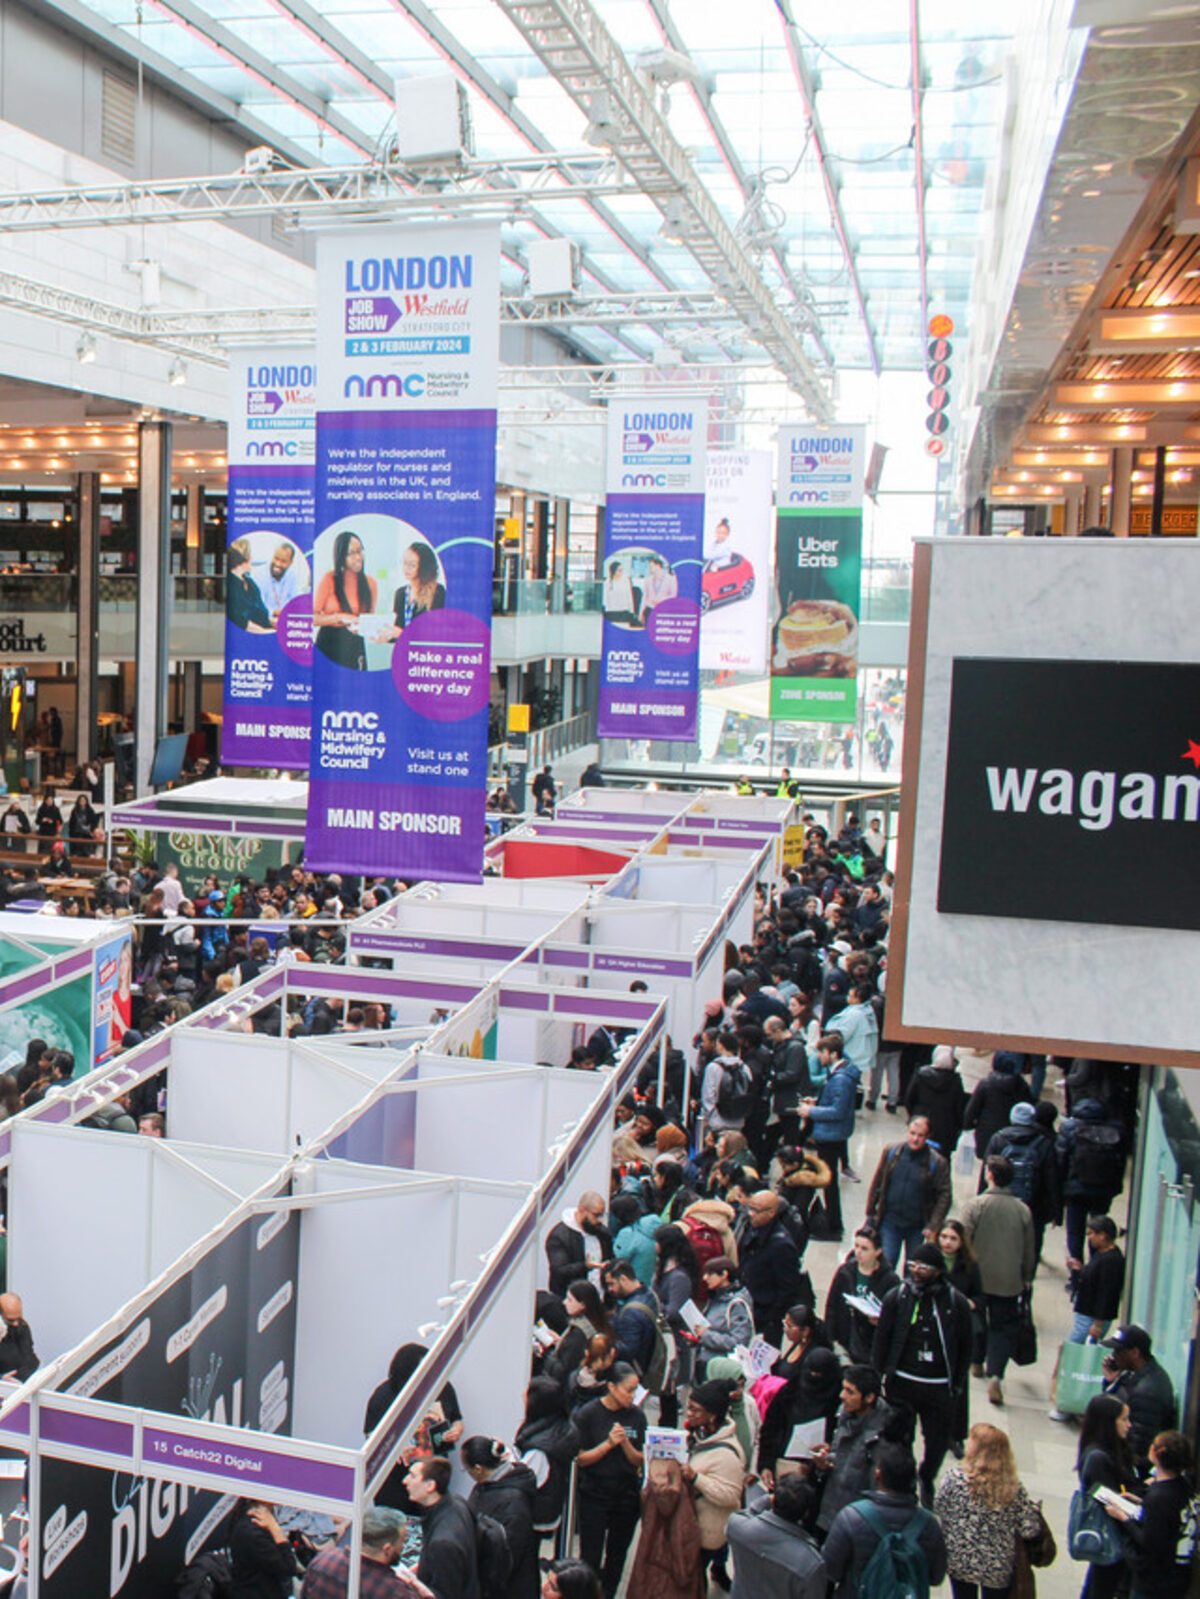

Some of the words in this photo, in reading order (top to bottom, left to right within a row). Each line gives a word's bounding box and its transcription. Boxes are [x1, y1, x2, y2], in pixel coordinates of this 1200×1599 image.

[345, 255, 472, 292] LONDON
[348, 300, 373, 315] JOB
[404, 295, 470, 317] Westfield
[348, 315, 388, 331] SHOW
[403, 322, 449, 333] STRATFORD
[452, 321, 470, 331] CITY
[352, 342, 359, 353] 2
[361, 342, 369, 353] &
[371, 341, 378, 352] 3
[381, 340, 434, 352] FEBRUARY
[437, 339, 462, 350] 2024
[427, 372, 462, 382] Nursing
[465, 372, 469, 380] &
[344, 373, 424, 397] nmc
[427, 381, 469, 390] Midwifery
[931, 339, 948, 433] BOWL
[427, 389, 459, 397] Council
[623, 413, 693, 430] LONDON
[246, 441, 298, 456] nmc
[791, 438, 853, 454] LONDON
[328, 448, 356, 458] We're
[359, 448, 377, 458] the
[379, 448, 446, 461] independent
[327, 462, 374, 473] regulator
[376, 462, 391, 472] for
[394, 463, 428, 472] nurses
[431, 462, 451, 472] and
[327, 476, 375, 486] midwives
[377, 476, 387, 486] in
[390, 476, 407, 486] the
[409, 476, 428, 487] UK,
[431, 475, 450, 486] and
[622, 474, 667, 486] nmc
[327, 490, 364, 502] nursing
[367, 490, 420, 500] associates
[423, 490, 433, 500] in
[436, 489, 482, 502] England.
[789, 491, 829, 502] nmc
[798, 537, 839, 552] Uber
[798, 552, 839, 568] Eats
[409, 651, 441, 663] Make
[445, 654, 452, 664] a
[457, 653, 482, 664] real
[608, 651, 640, 661] nmc
[231, 659, 269, 671] nmc
[408, 667, 474, 679] difference
[408, 682, 442, 695] every
[447, 683, 471, 696] day
[611, 703, 637, 715] MAIN
[640, 703, 685, 717] SPONSOR
[322, 710, 379, 729] nmc
[236, 723, 266, 737] MAIN
[321, 729, 374, 744] Nursing
[377, 732, 386, 743] &
[321, 743, 386, 759] Midwifery
[408, 748, 435, 761] Visit
[438, 751, 452, 761] us
[455, 751, 469, 761] at
[320, 755, 368, 769] Council
[407, 763, 441, 775] stand
[445, 766, 469, 776] one
[327, 808, 374, 829] MAIN
[379, 812, 461, 835] SPONSOR
[154, 1440, 168, 1453] 15
[173, 1444, 221, 1464] Catch22
[224, 1454, 262, 1472] Digital
